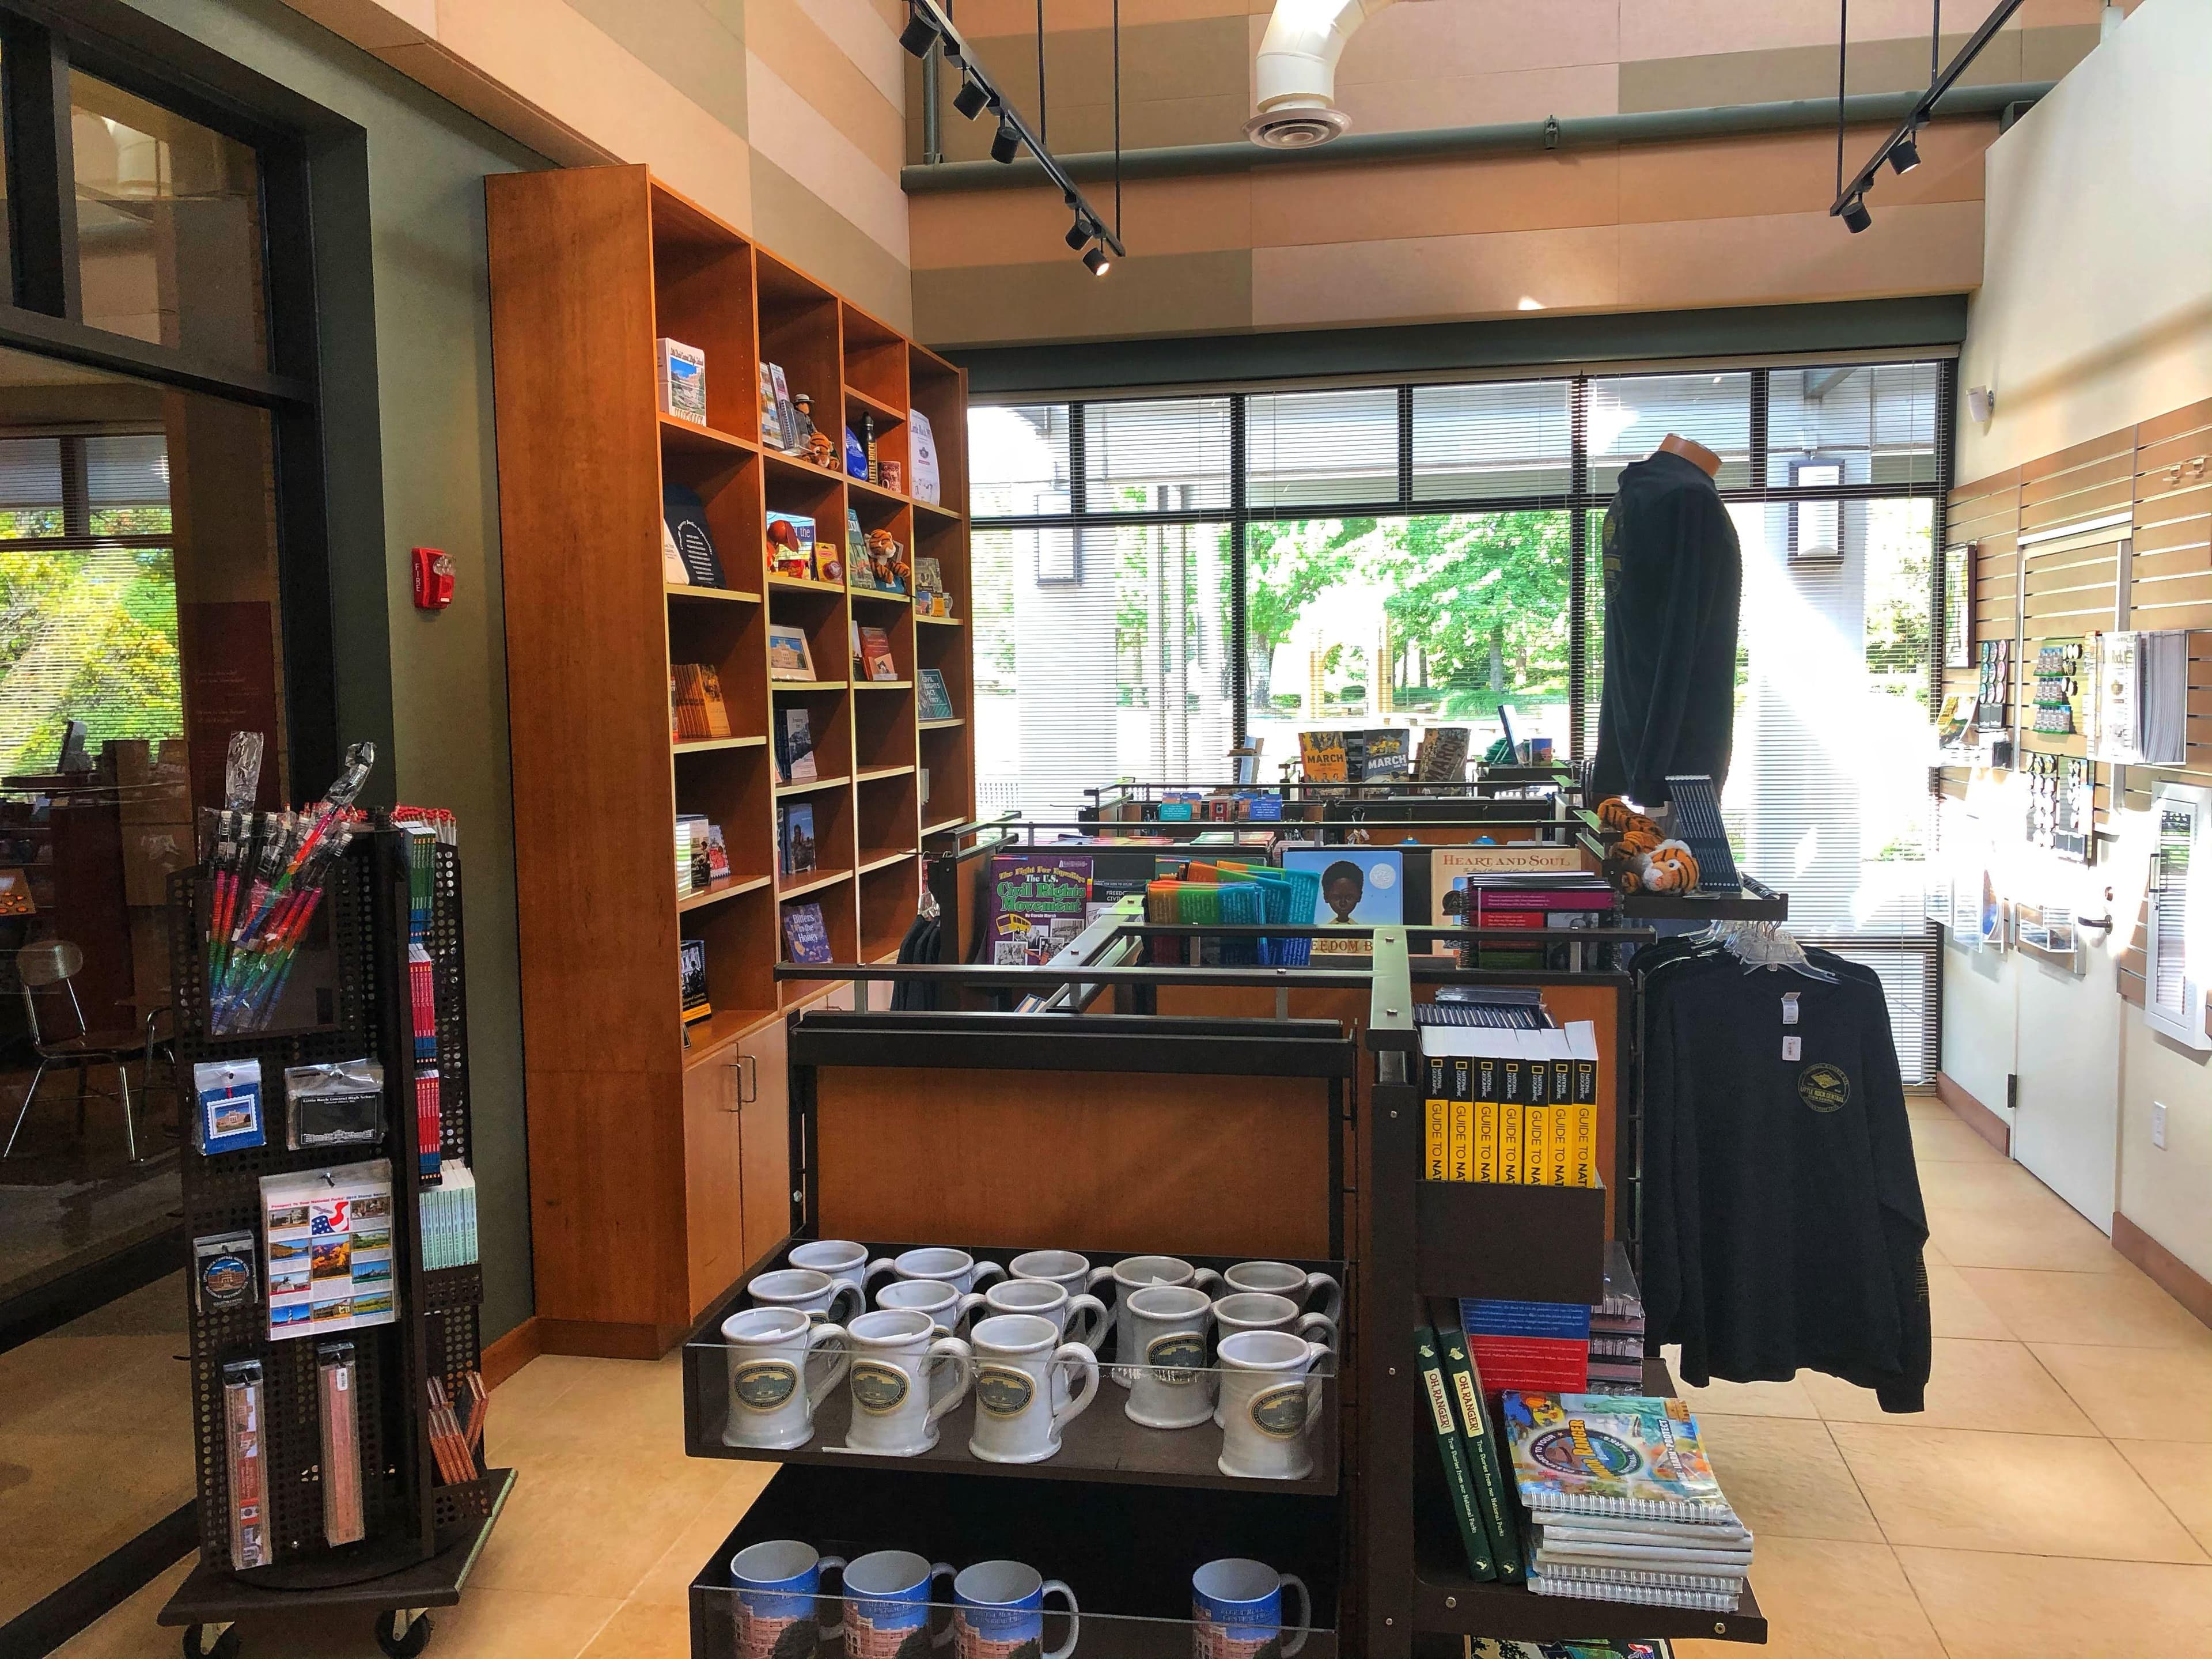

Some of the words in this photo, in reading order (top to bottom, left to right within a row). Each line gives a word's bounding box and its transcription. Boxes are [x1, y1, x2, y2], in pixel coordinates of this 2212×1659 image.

[800, 527, 810, 537] the
[1307, 755, 1343, 764] MARCH
[1368, 755, 1407, 770] MARCH
[998, 871, 1013, 880] The
[1015, 866, 1035, 876] Fight
[997, 881, 1033, 897] Civil
[1036, 883, 1086, 902] Rights
[1000, 897, 1082, 912] Movement
[793, 914, 815, 924] Bitters
[798, 933, 818, 942] Honey
[1311, 940, 1359, 952] EEDOM
[1432, 1103, 1442, 1139] GUIDE
[1456, 1105, 1466, 1141] GUIDE
[1481, 1106, 1491, 1142] GUIDE
[1506, 1108, 1516, 1143] GUIDE
[1531, 1111, 1542, 1146] GUIDE
[1556, 1109, 1566, 1143] GUIDE
[1579, 1108, 1589, 1143] GUIDE
[1432, 1142, 1442, 1157] TO
[1456, 1144, 1466, 1159] TO
[1481, 1145, 1491, 1160] TO
[1506, 1146, 1516, 1161] TO
[1531, 1149, 1541, 1164] TO
[1555, 1148, 1565, 1163] TO
[1578, 1146, 1588, 1161] TO
[1429, 1373, 1440, 1389] OH,
[1459, 1376, 1469, 1392] OH,
[1433, 1388, 1451, 1429] RANGER!
[1463, 1391, 1480, 1431] RANGER!
[1539, 1434, 1556, 1446] YOUR
[1569, 1419, 1596, 1456] RANGER
[1658, 1419, 1672, 1448] PROTECT
[1603, 1436, 1631, 1453] PARKS
[1451, 1450, 1460, 1469] Stories
[1463, 1494, 1474, 1518] National
[1480, 1453, 1488, 1472] Stories
[1491, 1498, 1502, 1521] National
